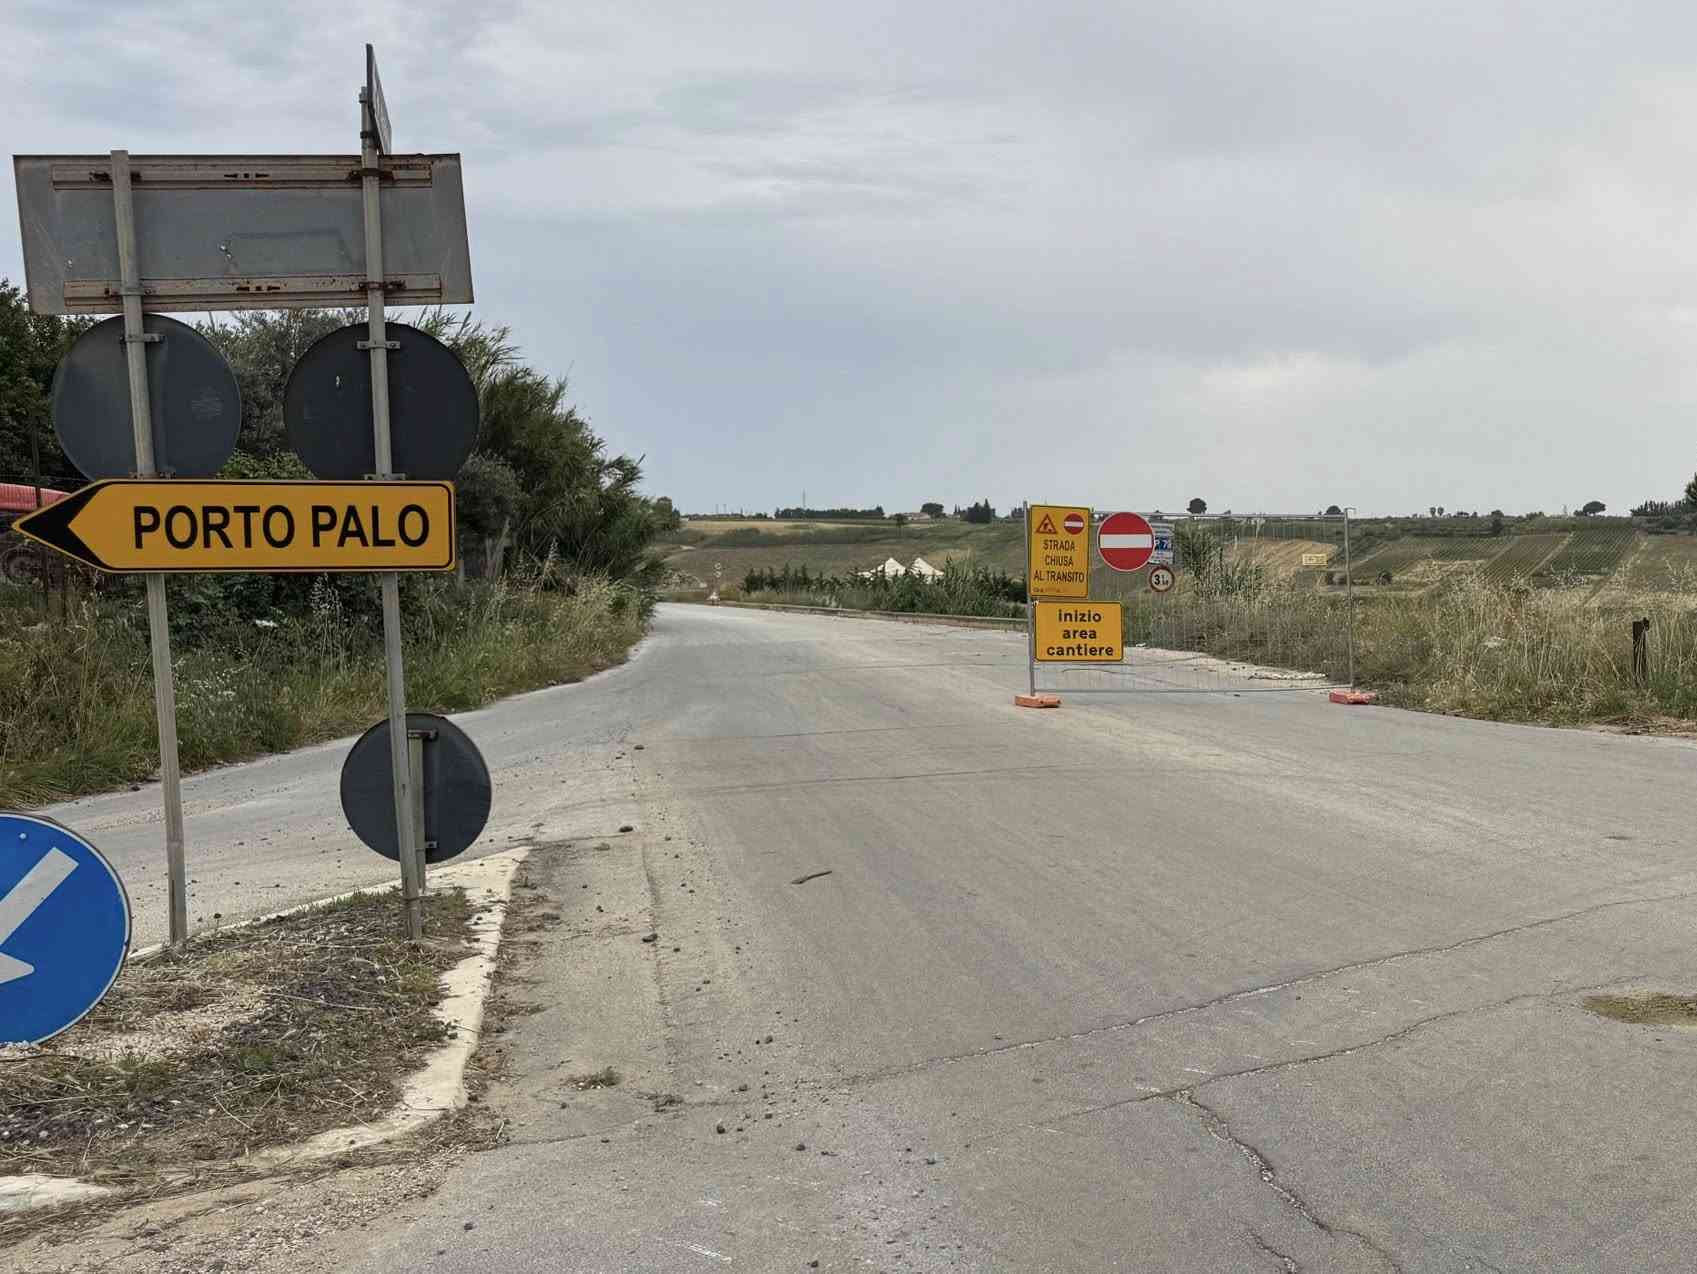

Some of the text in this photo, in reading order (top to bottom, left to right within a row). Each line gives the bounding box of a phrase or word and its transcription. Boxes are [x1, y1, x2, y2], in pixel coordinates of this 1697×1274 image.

[133, 504, 430, 549] PORTO PALO
[1042, 539, 1076, 551] STRADA
[1044, 555, 1074, 567] CHIUSA
[1033, 570, 1085, 584] AL TRANSITO
[1058, 609, 1102, 623] inizio
[1062, 628, 1097, 639] area
[1047, 643, 1114, 657] cantiere
